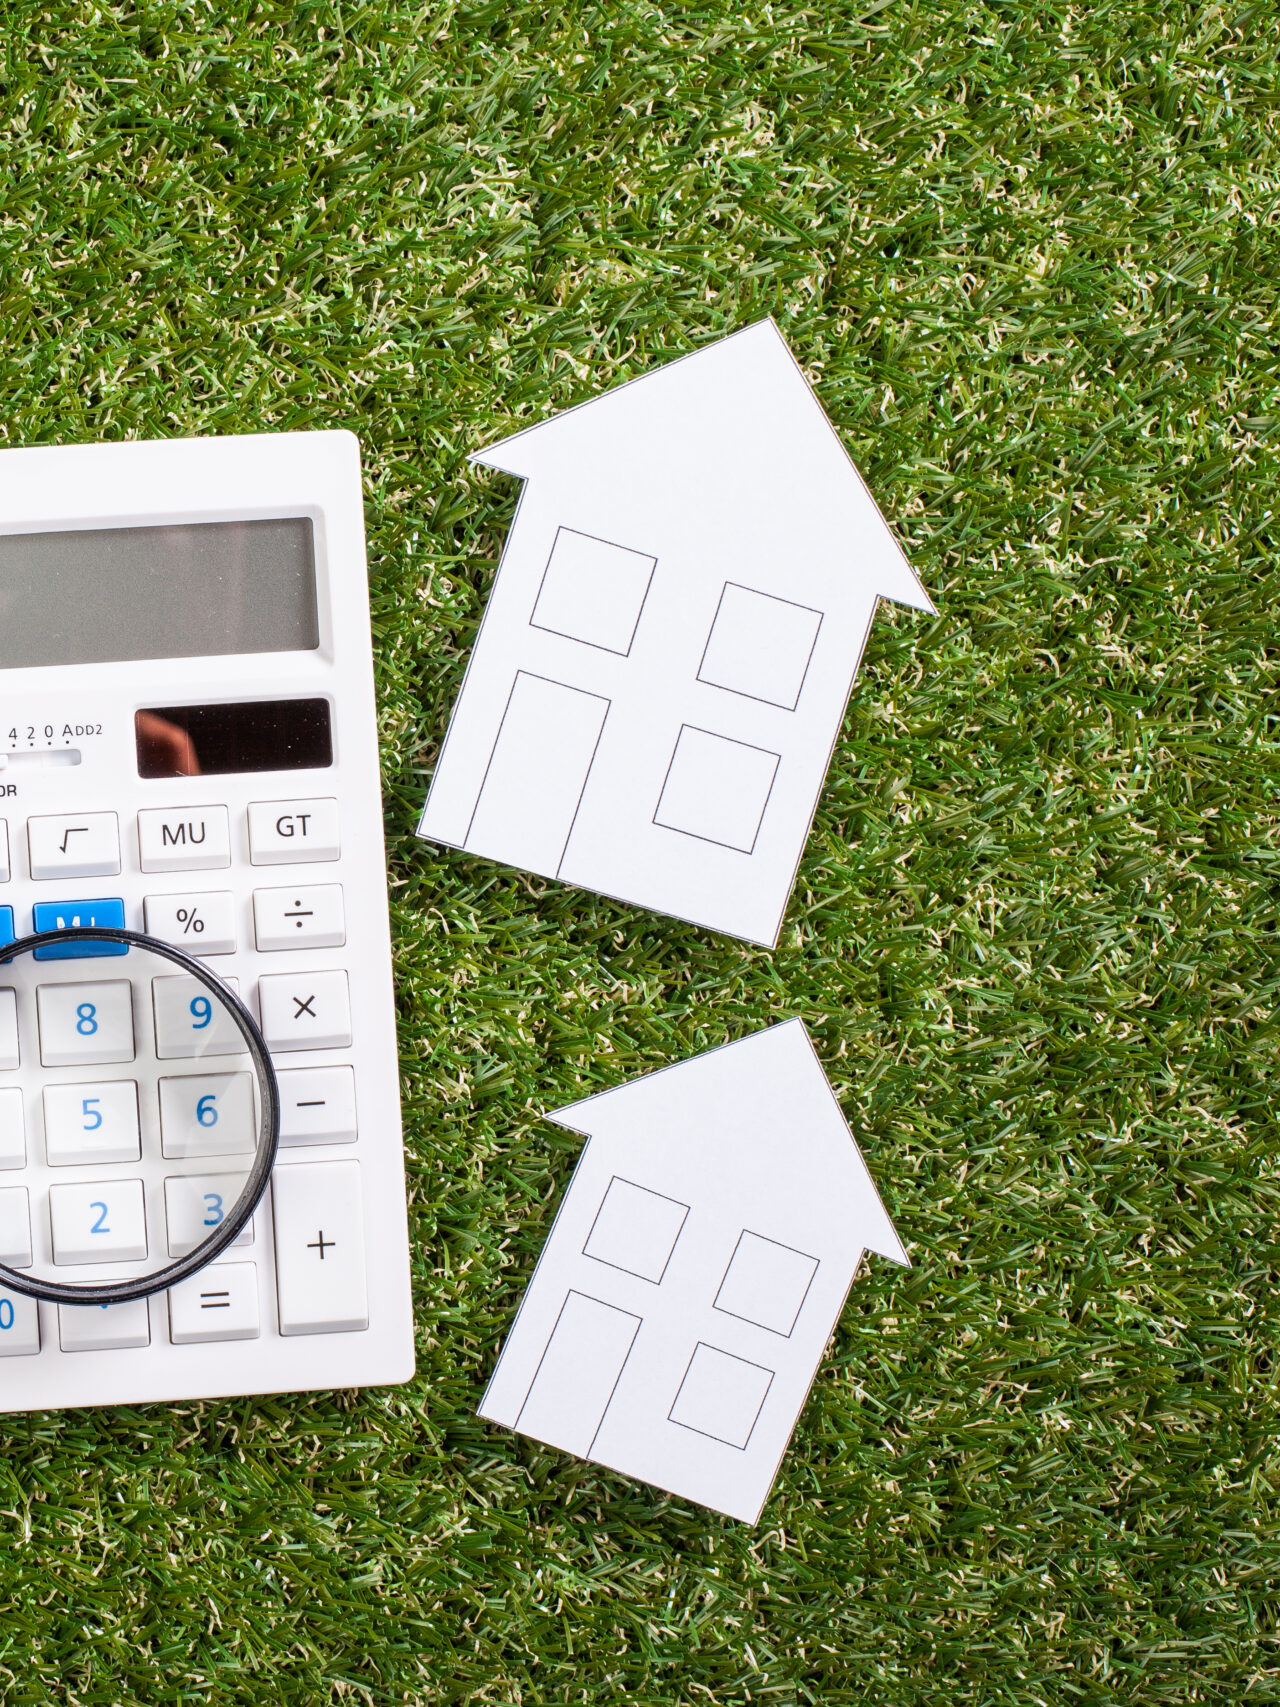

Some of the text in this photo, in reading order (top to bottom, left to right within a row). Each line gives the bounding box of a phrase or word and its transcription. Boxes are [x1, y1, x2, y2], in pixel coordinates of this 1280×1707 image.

[8, 726, 19, 741] 4
[27, 725, 36, 741] 2
[44, 724, 55, 739] 0
[62, 723, 103, 738] ADD2
[162, 821, 206, 846] MU
[276, 814, 312, 838] GT
[176, 907, 205, 934] %
[75, 1002, 99, 1037] 8
[189, 995, 213, 1030] 9
[81, 1098, 103, 1131] 5
[195, 1094, 219, 1128] 6
[89, 1201, 111, 1235] 2
[203, 1193, 225, 1227] 3
